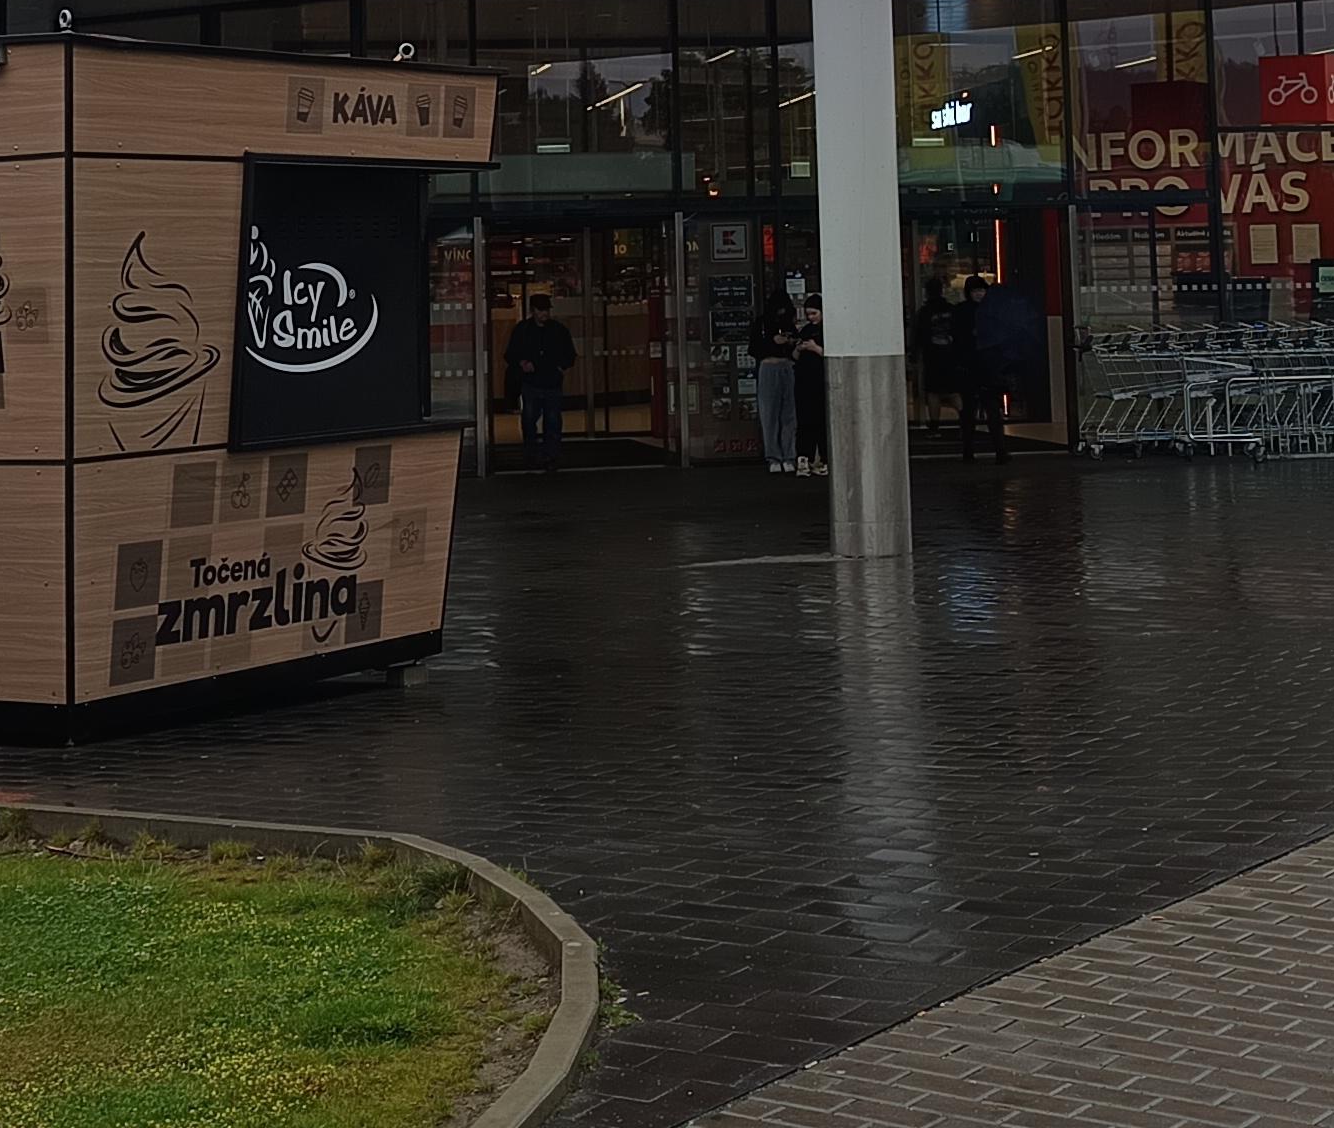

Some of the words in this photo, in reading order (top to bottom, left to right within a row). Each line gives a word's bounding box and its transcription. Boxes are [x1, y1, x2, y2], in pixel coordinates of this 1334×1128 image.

[332, 86, 397, 126] KÁVA
[283, 269, 326, 322] Icy
[272, 309, 358, 350] Smile
[190, 552, 270, 588] Točená
[155, 562, 357, 647] zmrzlina
